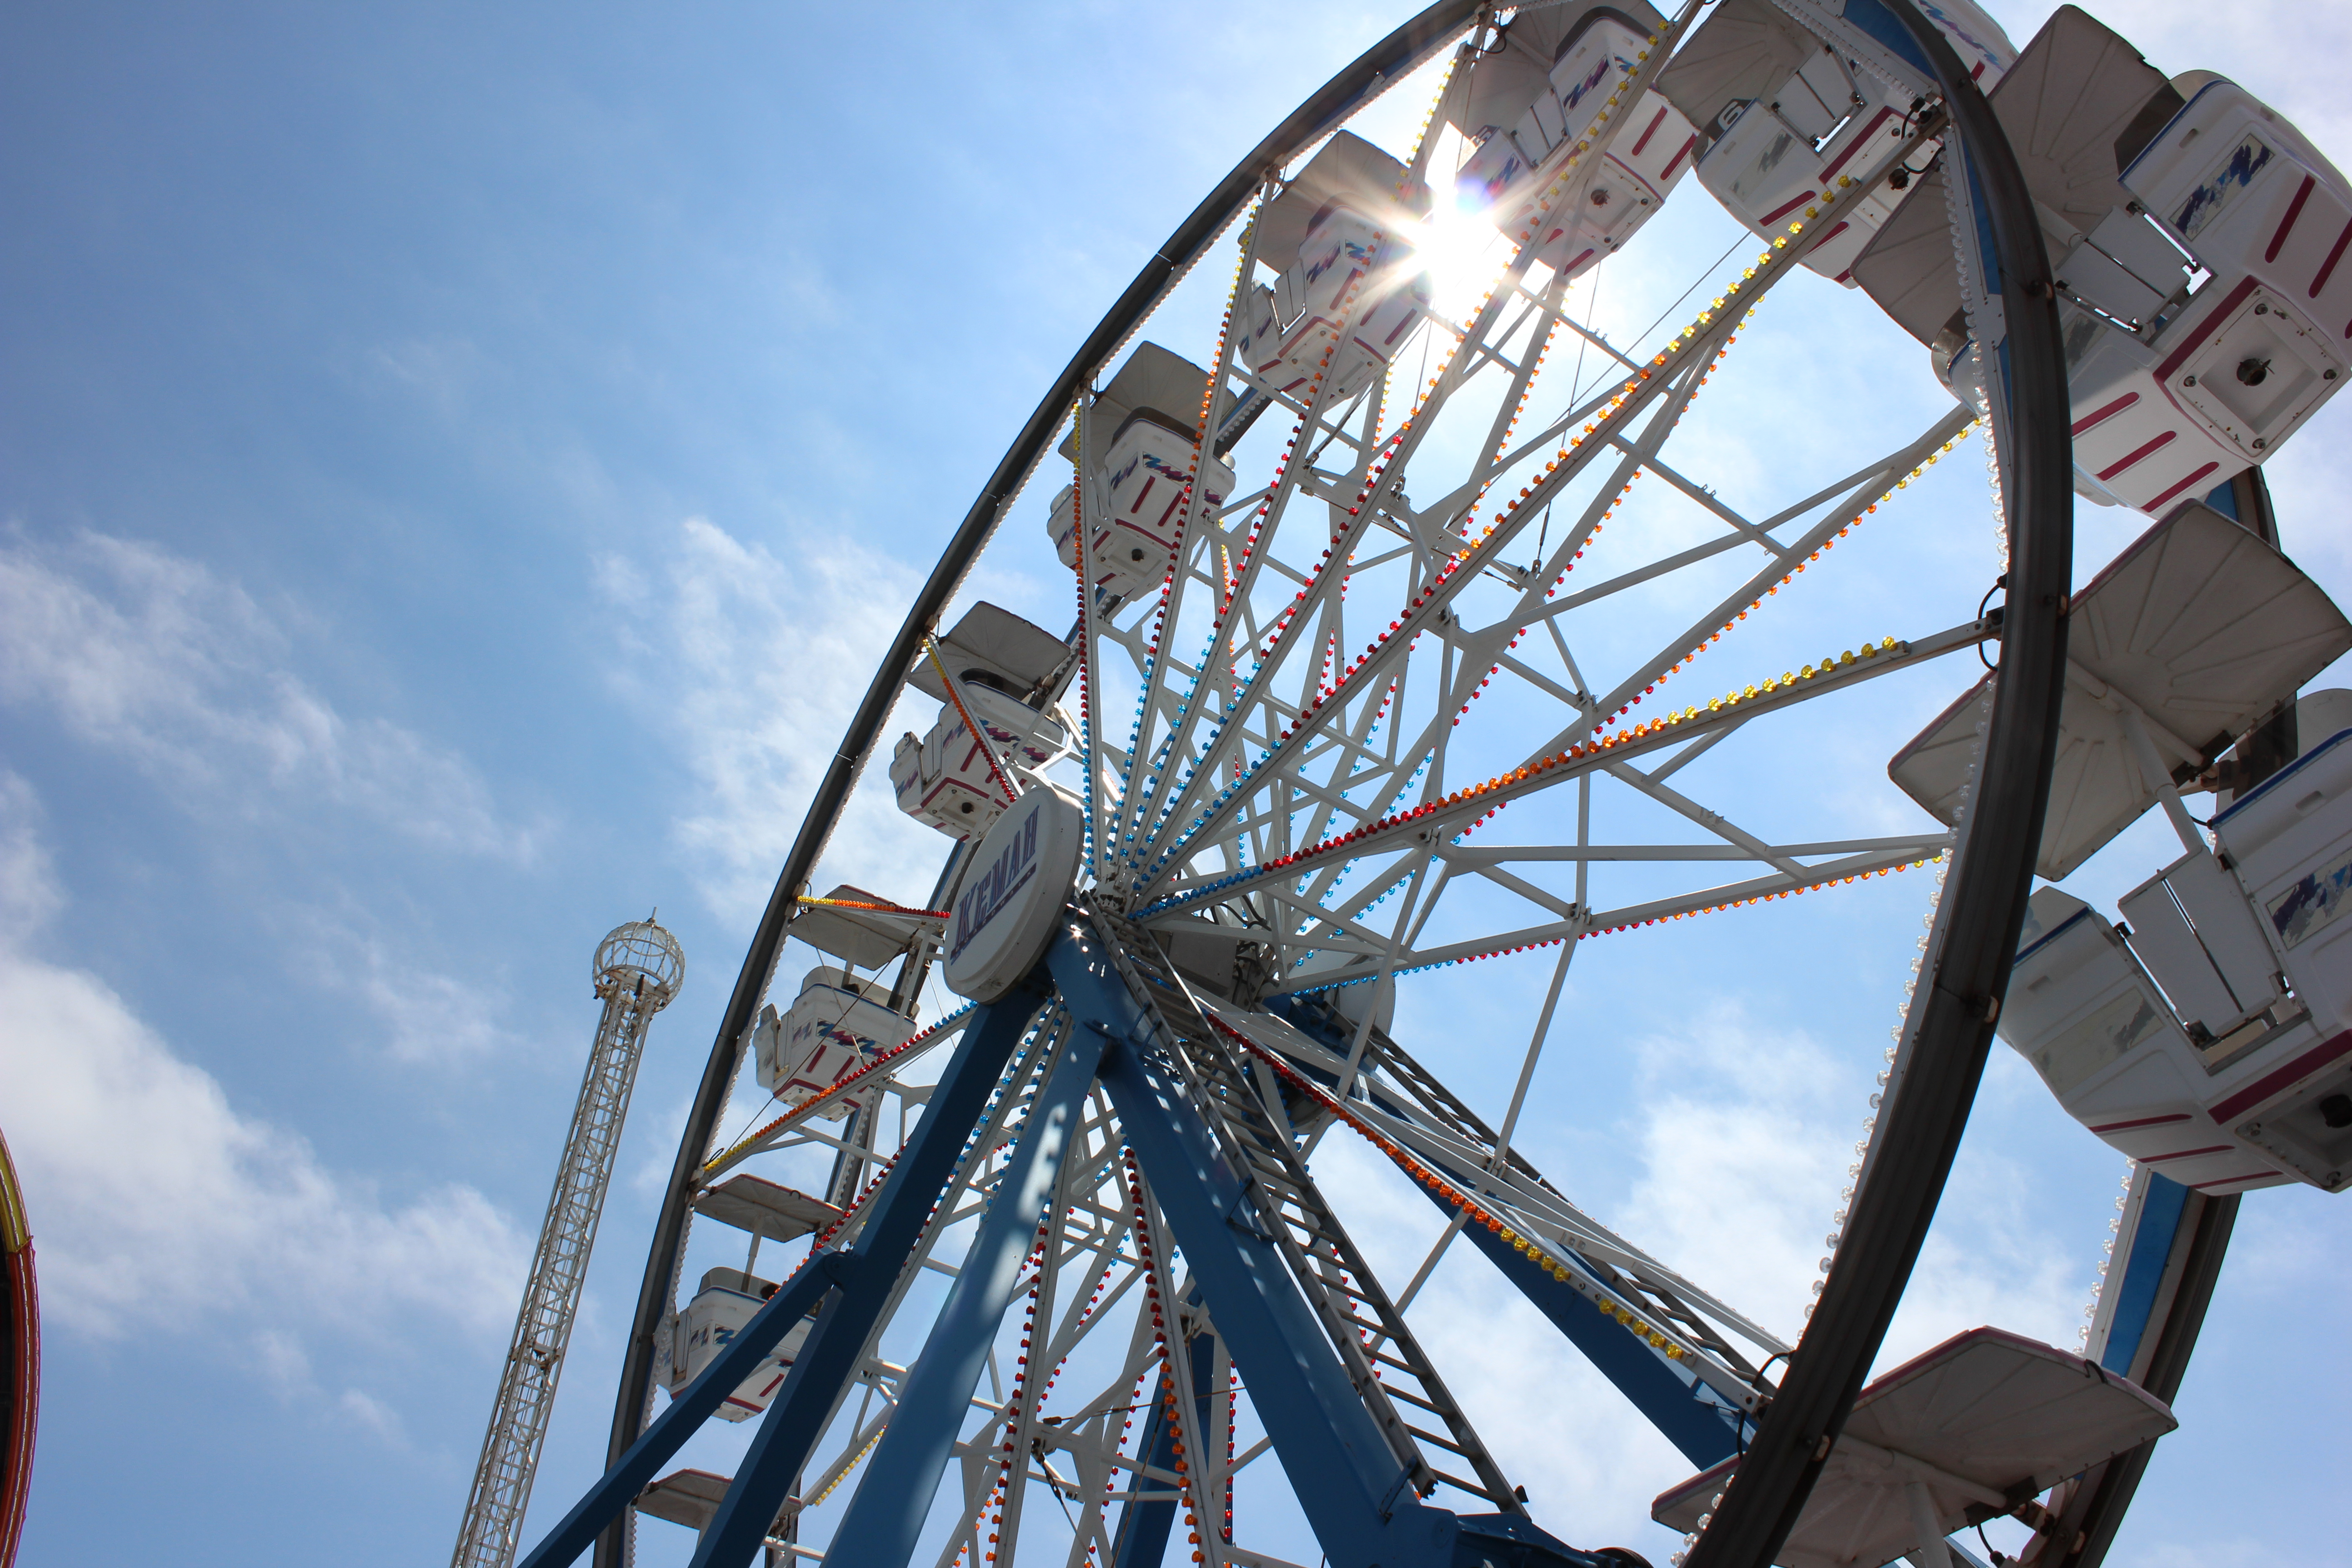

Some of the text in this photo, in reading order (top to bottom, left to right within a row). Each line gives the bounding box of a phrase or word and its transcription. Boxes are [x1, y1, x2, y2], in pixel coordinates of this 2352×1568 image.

[1718, 101, 1744, 131] 6
[951, 805, 1039, 965] KEMAH
[955, 870, 1032, 952] BOARDWALK
